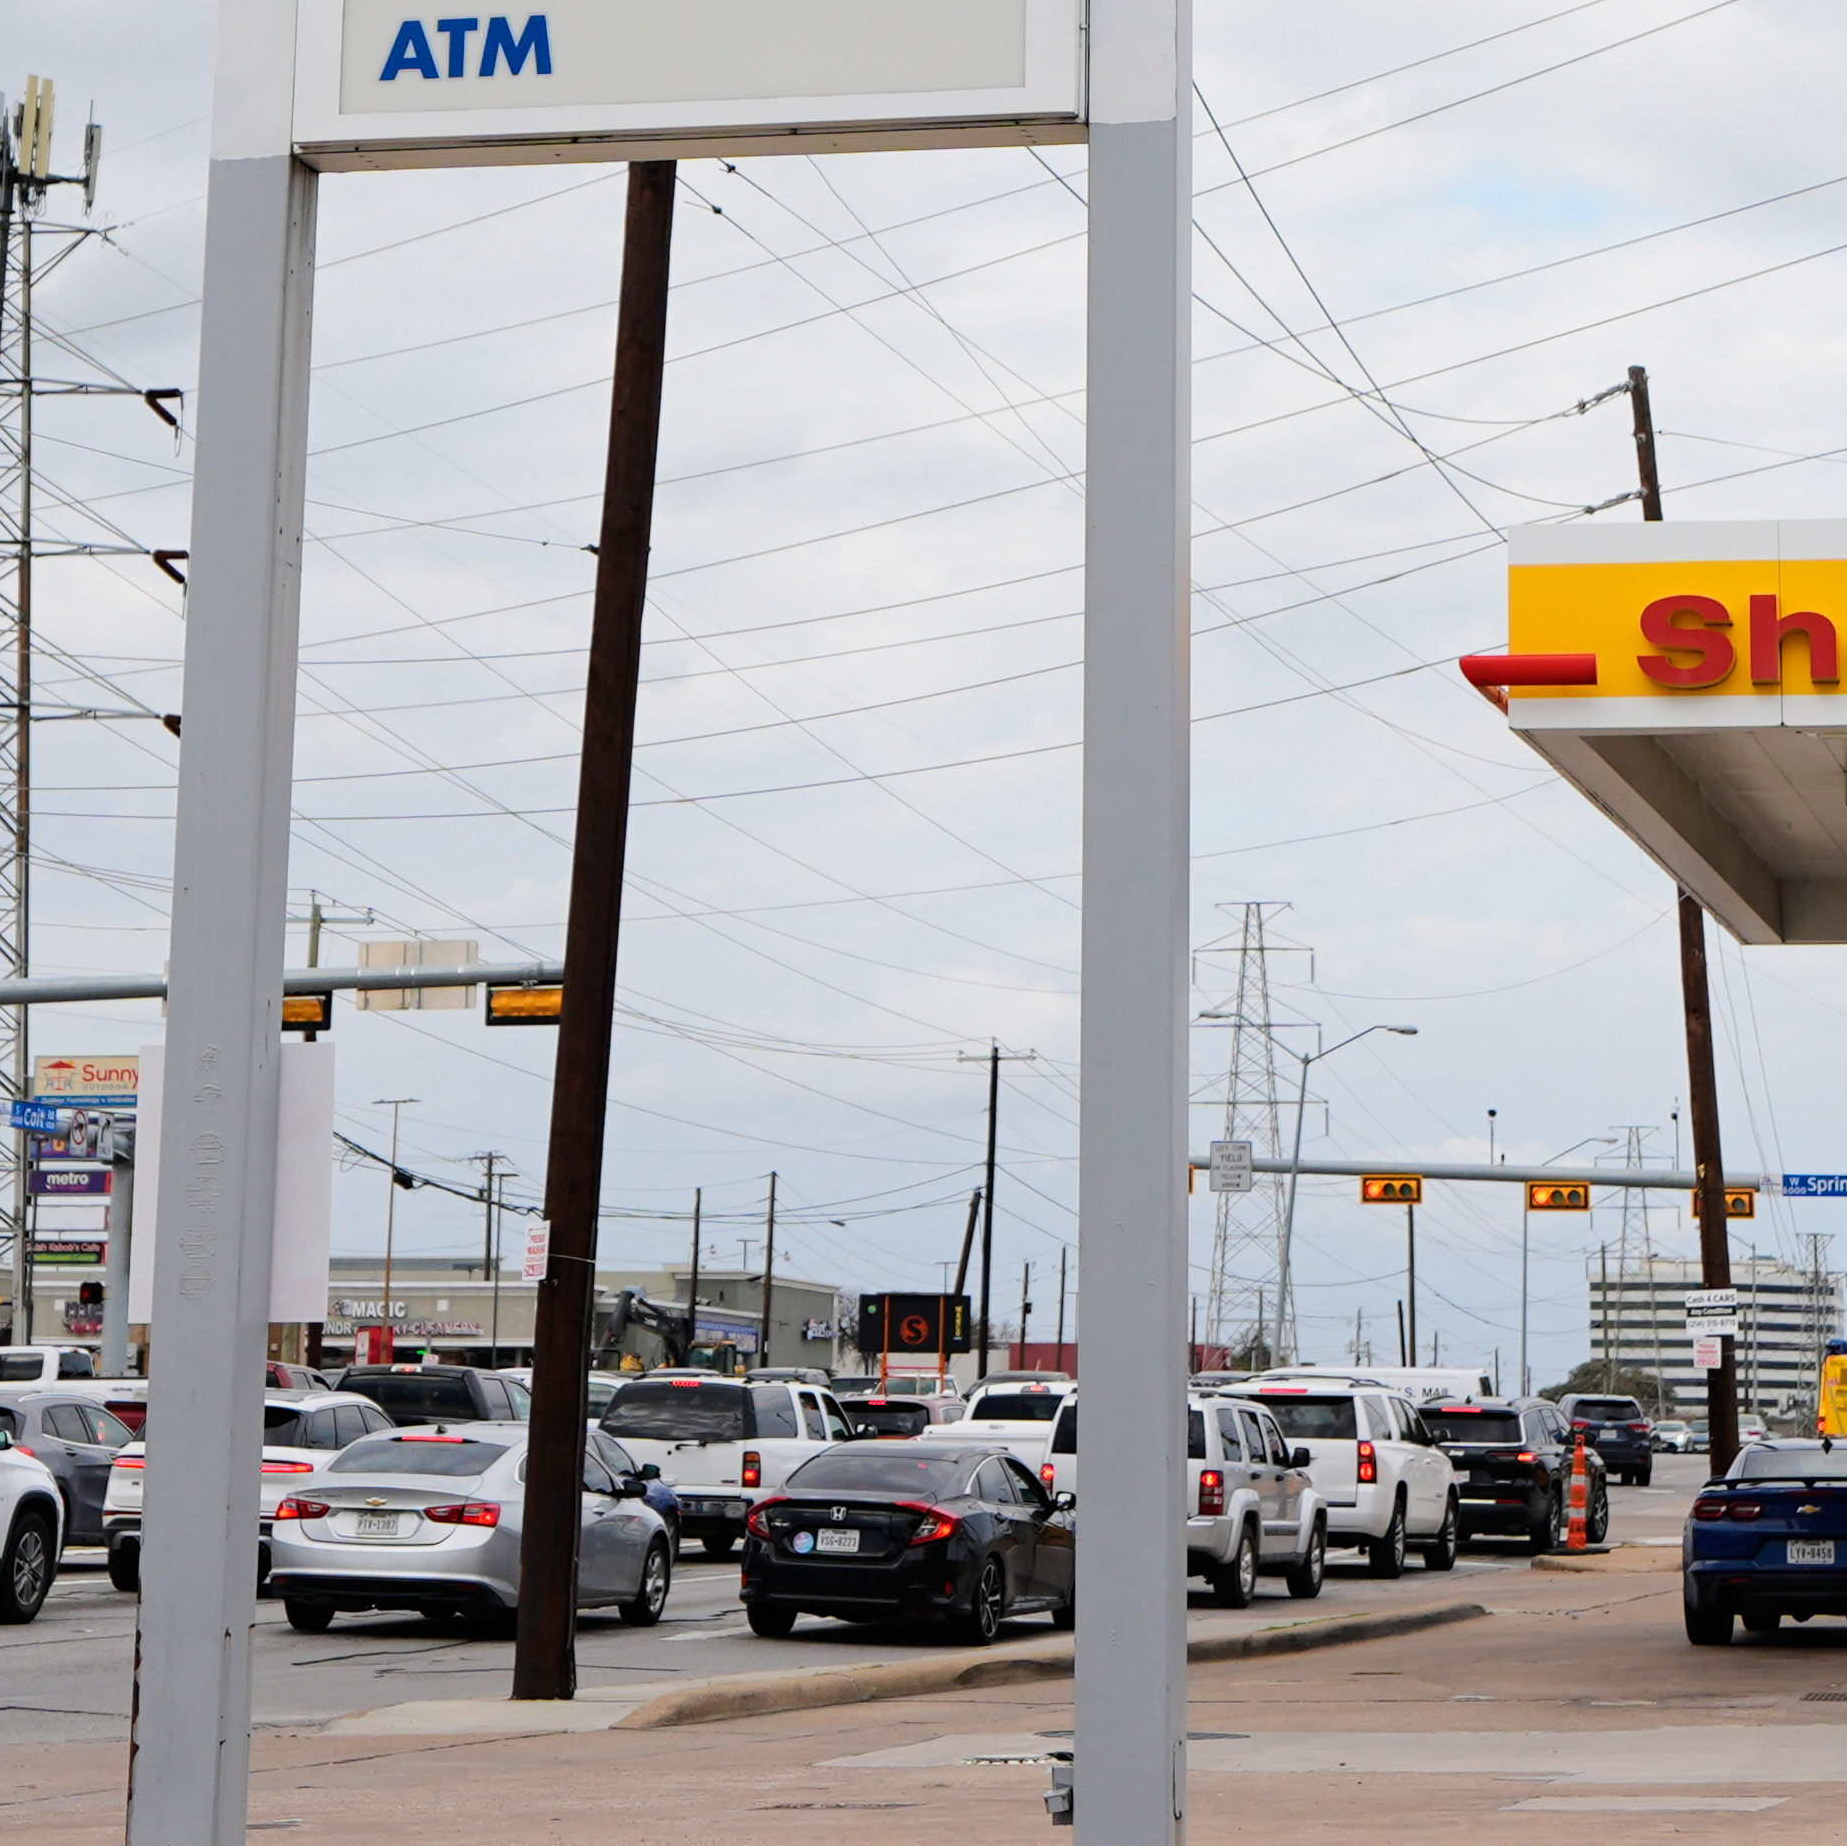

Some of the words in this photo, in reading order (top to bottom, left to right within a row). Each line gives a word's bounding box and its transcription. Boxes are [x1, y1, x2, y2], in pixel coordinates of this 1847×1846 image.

[378, 13, 554, 82] ATM
[81, 1064, 138, 1090] Sunny
[24, 1107, 44, 1128] Coit
[1220, 1154, 1242, 1163] YIELD
[46, 1171, 90, 1186] metro
[1788, 1177, 1800, 1187] W
[1713, 1293, 1735, 1303] CARS
[352, 1299, 407, 1319] MAGIC
